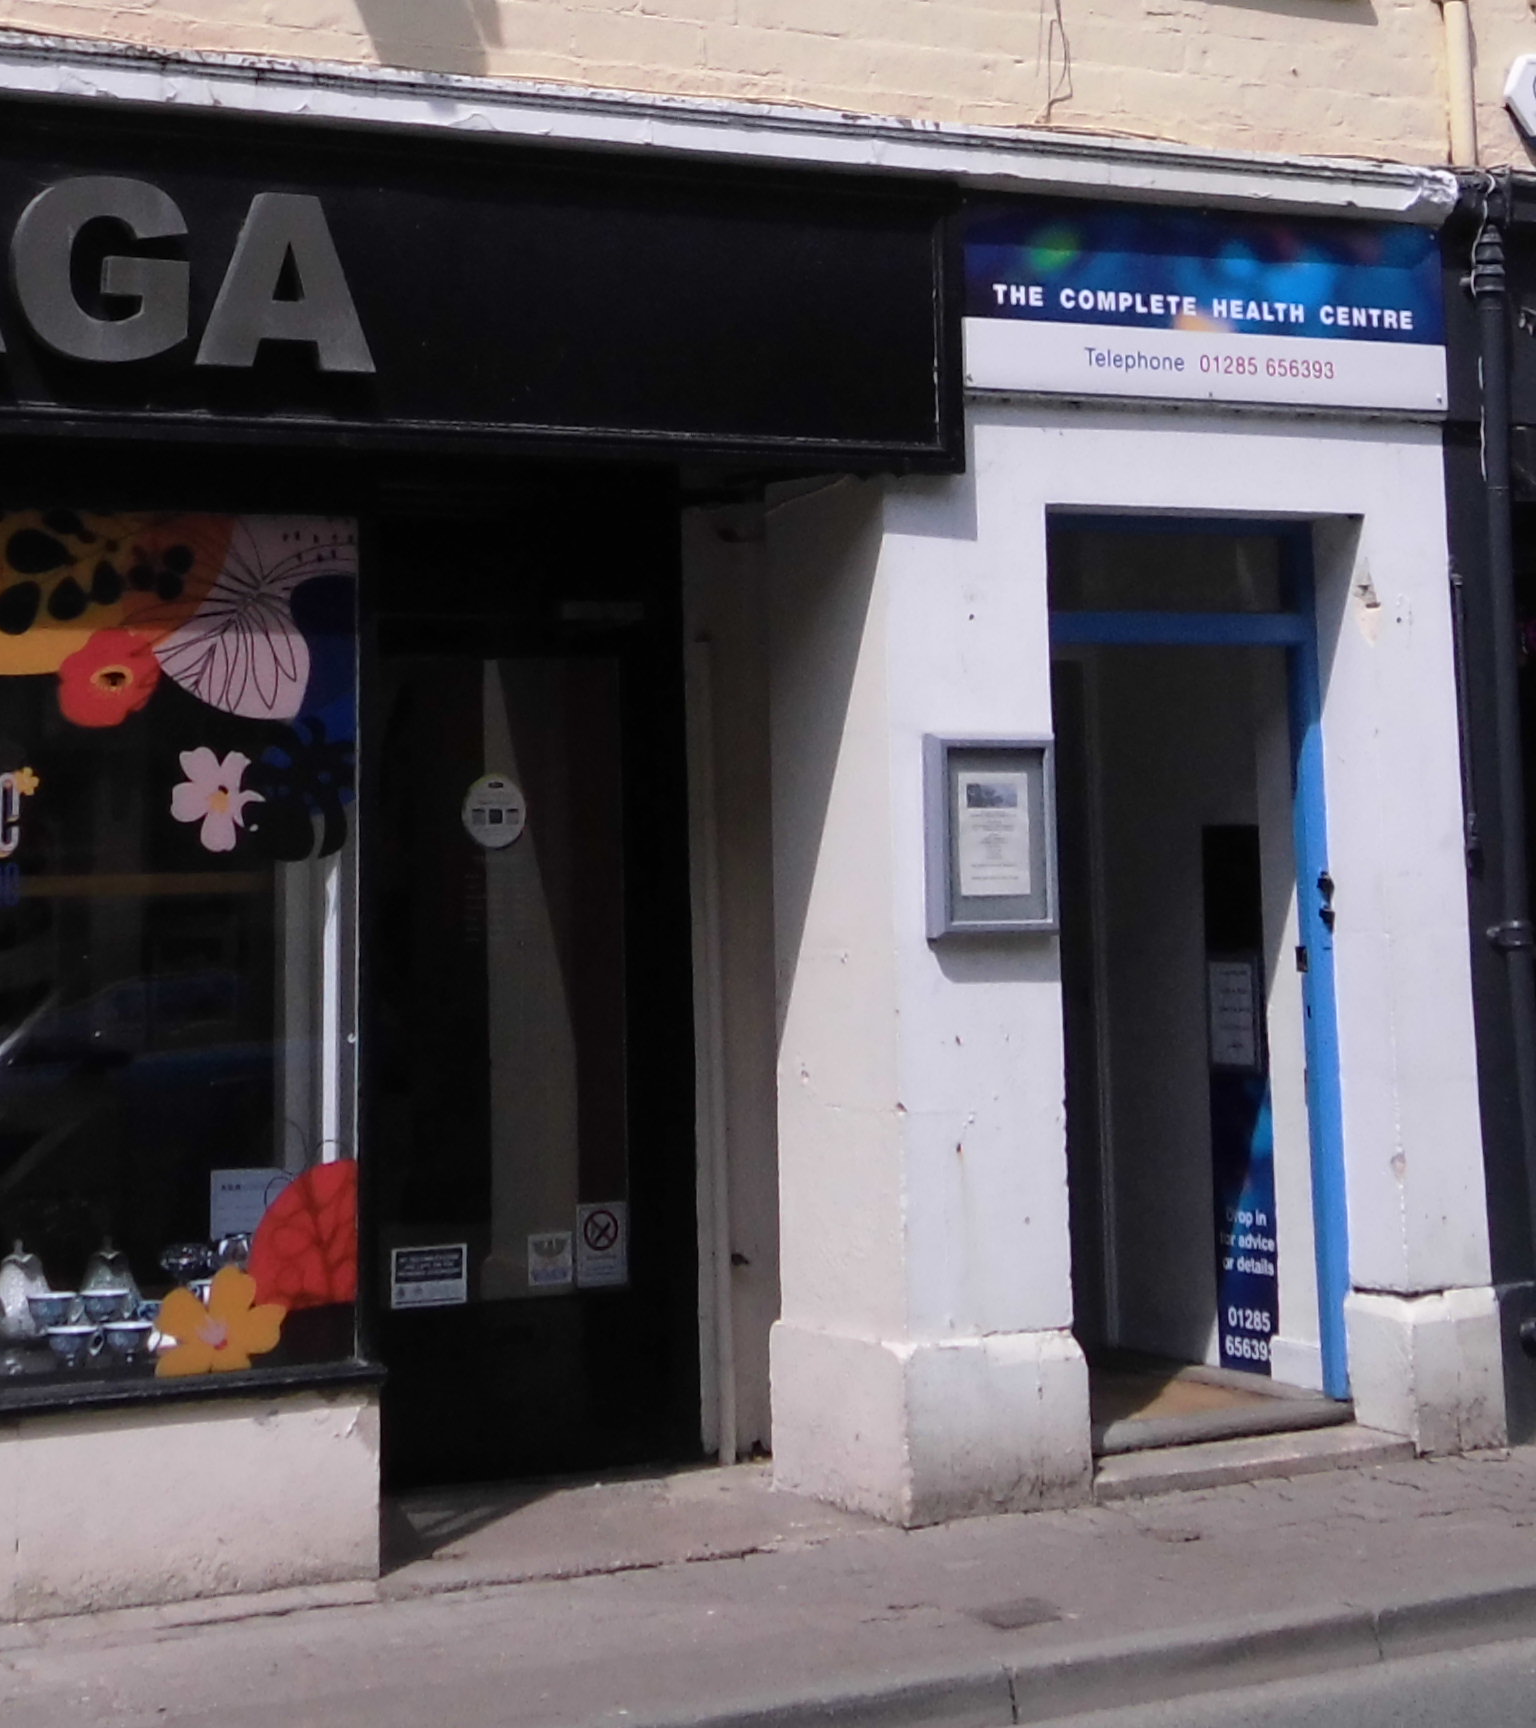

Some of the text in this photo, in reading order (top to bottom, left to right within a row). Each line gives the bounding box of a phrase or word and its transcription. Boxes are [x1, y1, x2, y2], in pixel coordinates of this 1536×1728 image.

[992, 283, 1414, 331] THE COMPLETE HEALTH CENTRE
[1084, 347, 1336, 381] Telephone 01285 656393
[1225, 1207, 1268, 1228] Drop in
[1238, 1232, 1276, 1253] advice
[1236, 1256, 1275, 1276] details
[1227, 1305, 1272, 1334] 01285
[1224, 1335, 1273, 1363] 65639
